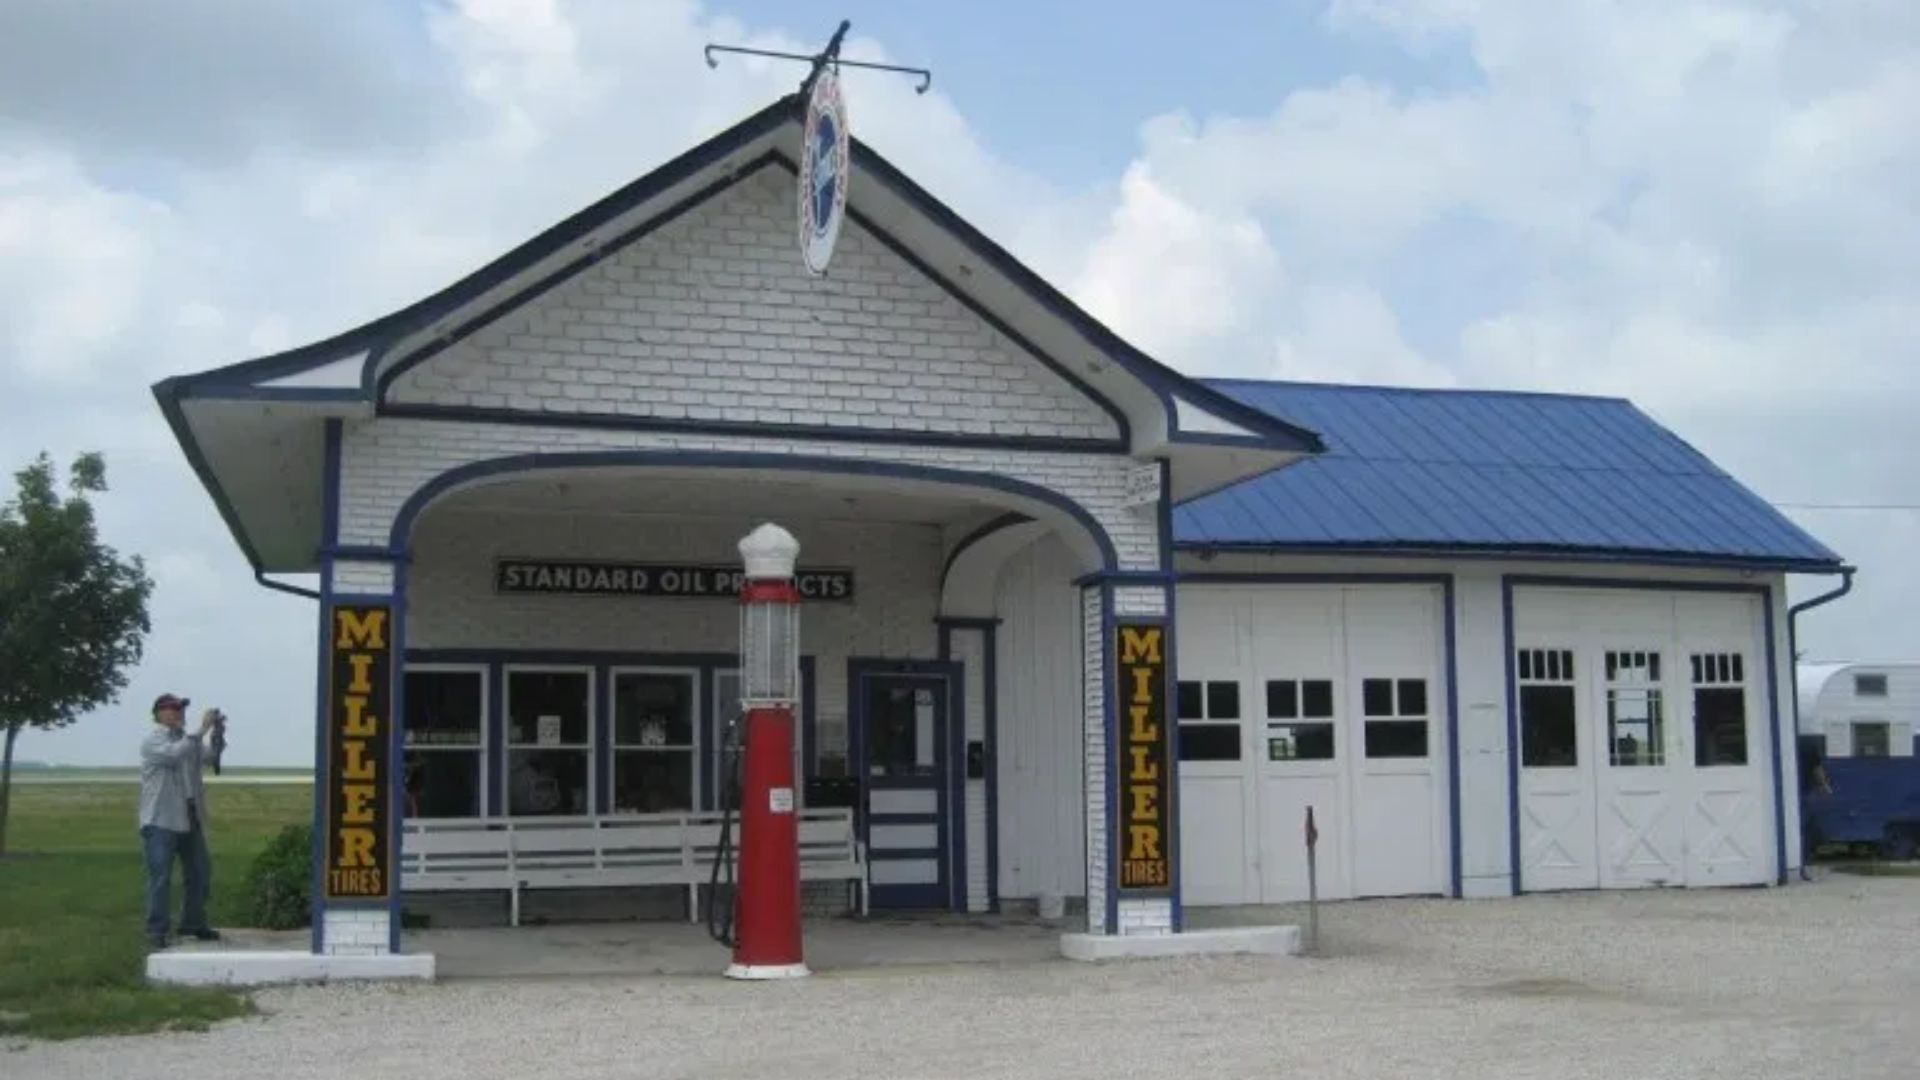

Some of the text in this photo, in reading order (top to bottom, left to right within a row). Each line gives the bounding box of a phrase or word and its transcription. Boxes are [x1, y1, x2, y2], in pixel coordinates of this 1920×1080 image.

[505, 564, 847, 597] STANDARD OIL PRCTS
[336, 609, 386, 867] MILLER
[1121, 628, 1161, 859] MILLER
[331, 868, 381, 894] TIRES
[1124, 859, 1166, 884] TIRES
